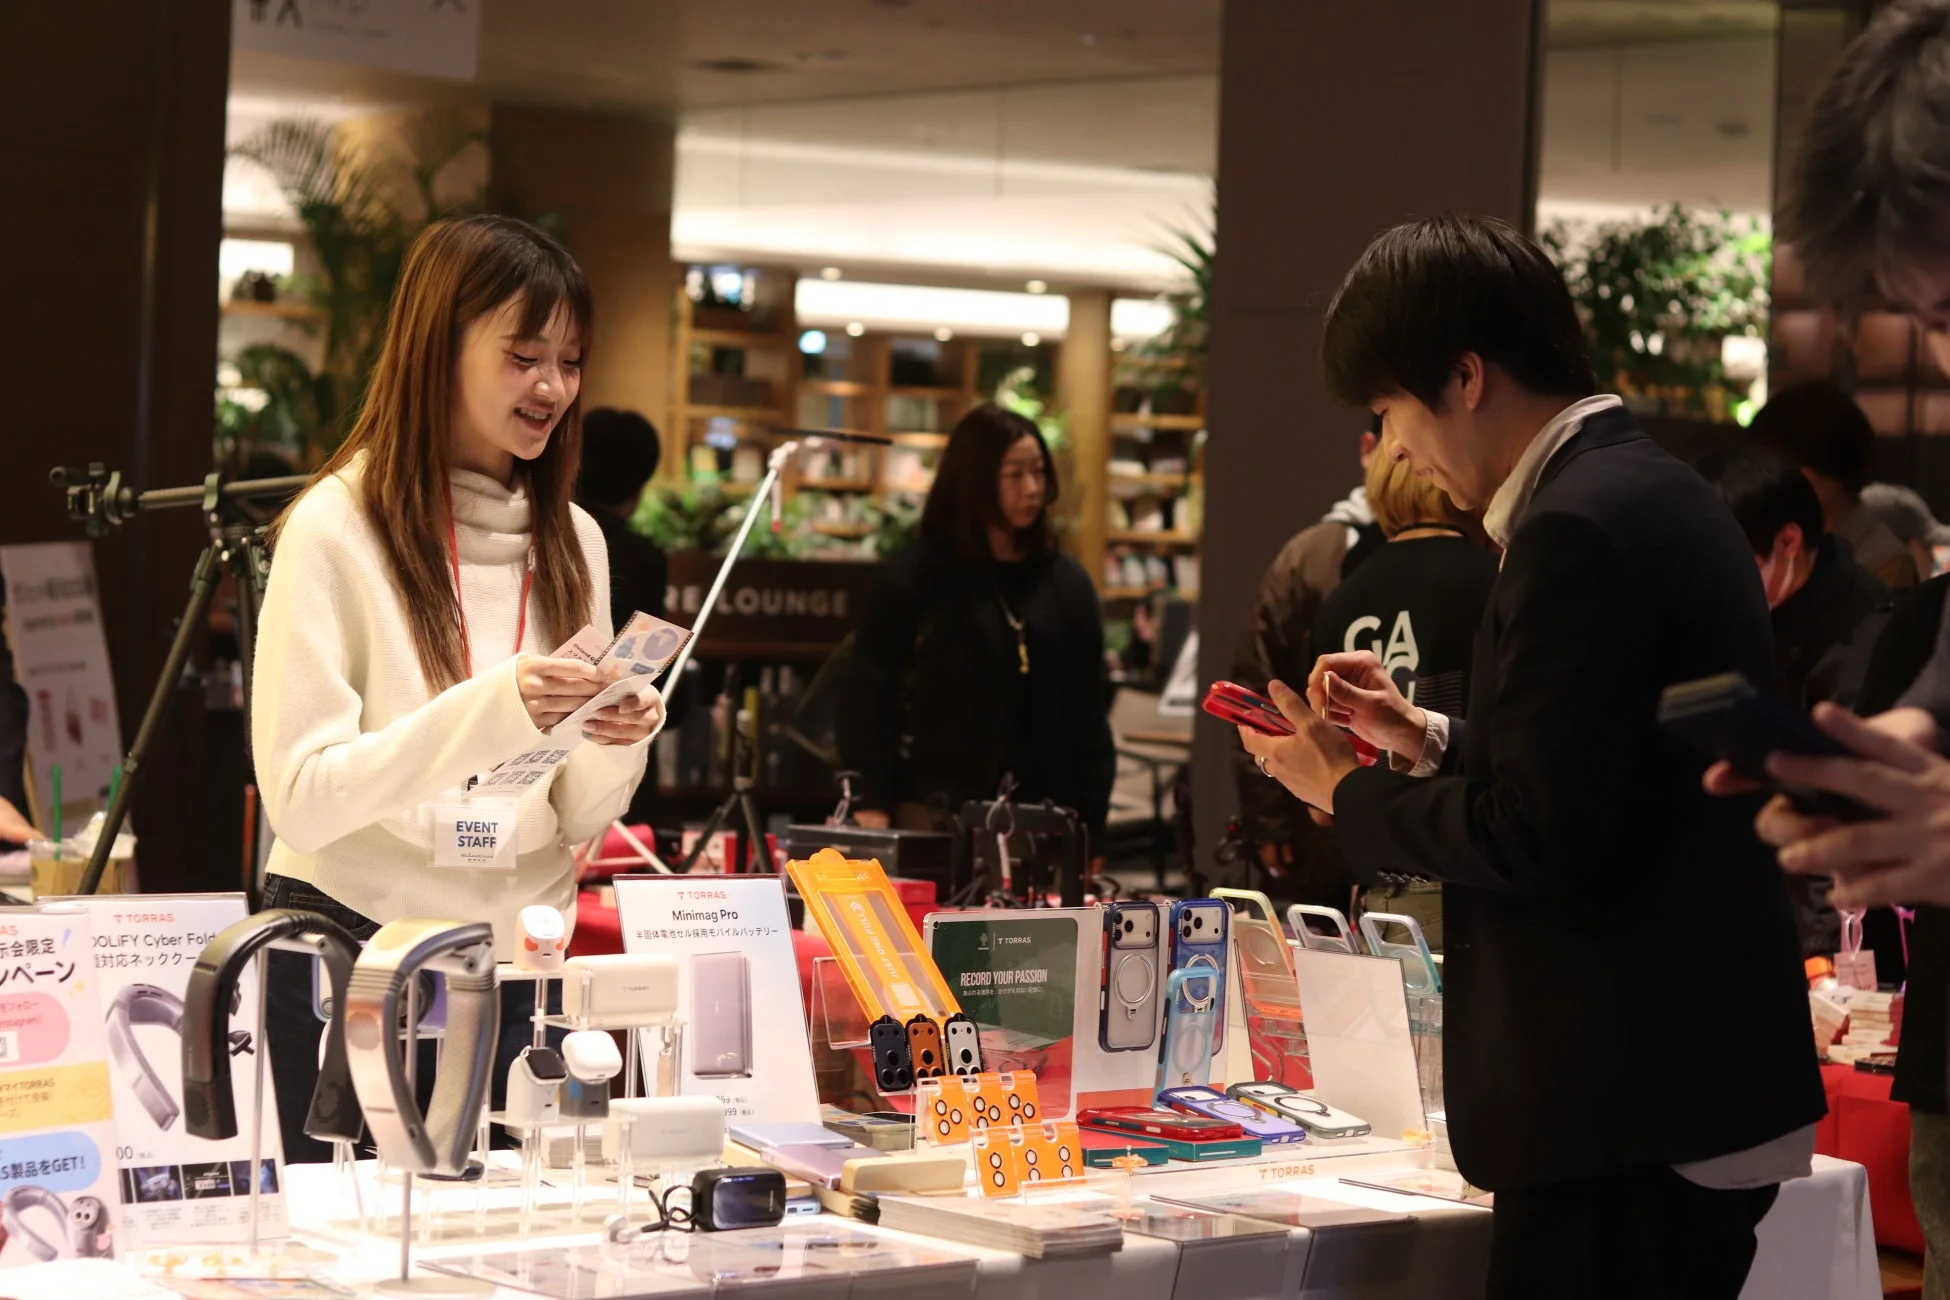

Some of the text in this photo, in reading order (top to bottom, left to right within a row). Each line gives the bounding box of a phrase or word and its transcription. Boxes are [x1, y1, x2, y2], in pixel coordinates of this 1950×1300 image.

[716, 587, 849, 616] LOUNGE
[456, 820, 499, 833] EVENT
[457, 835, 497, 848] STAFF
[688, 891, 727, 900] TORRAS
[126, 913, 175, 924] TORRAS
[671, 908, 739, 923] Minimag Pro
[144, 933, 182, 948] Cyber
[960, 968, 1048, 987] RECORD YOUR PASSION
[1271, 1165, 1315, 1179] TORRAS
